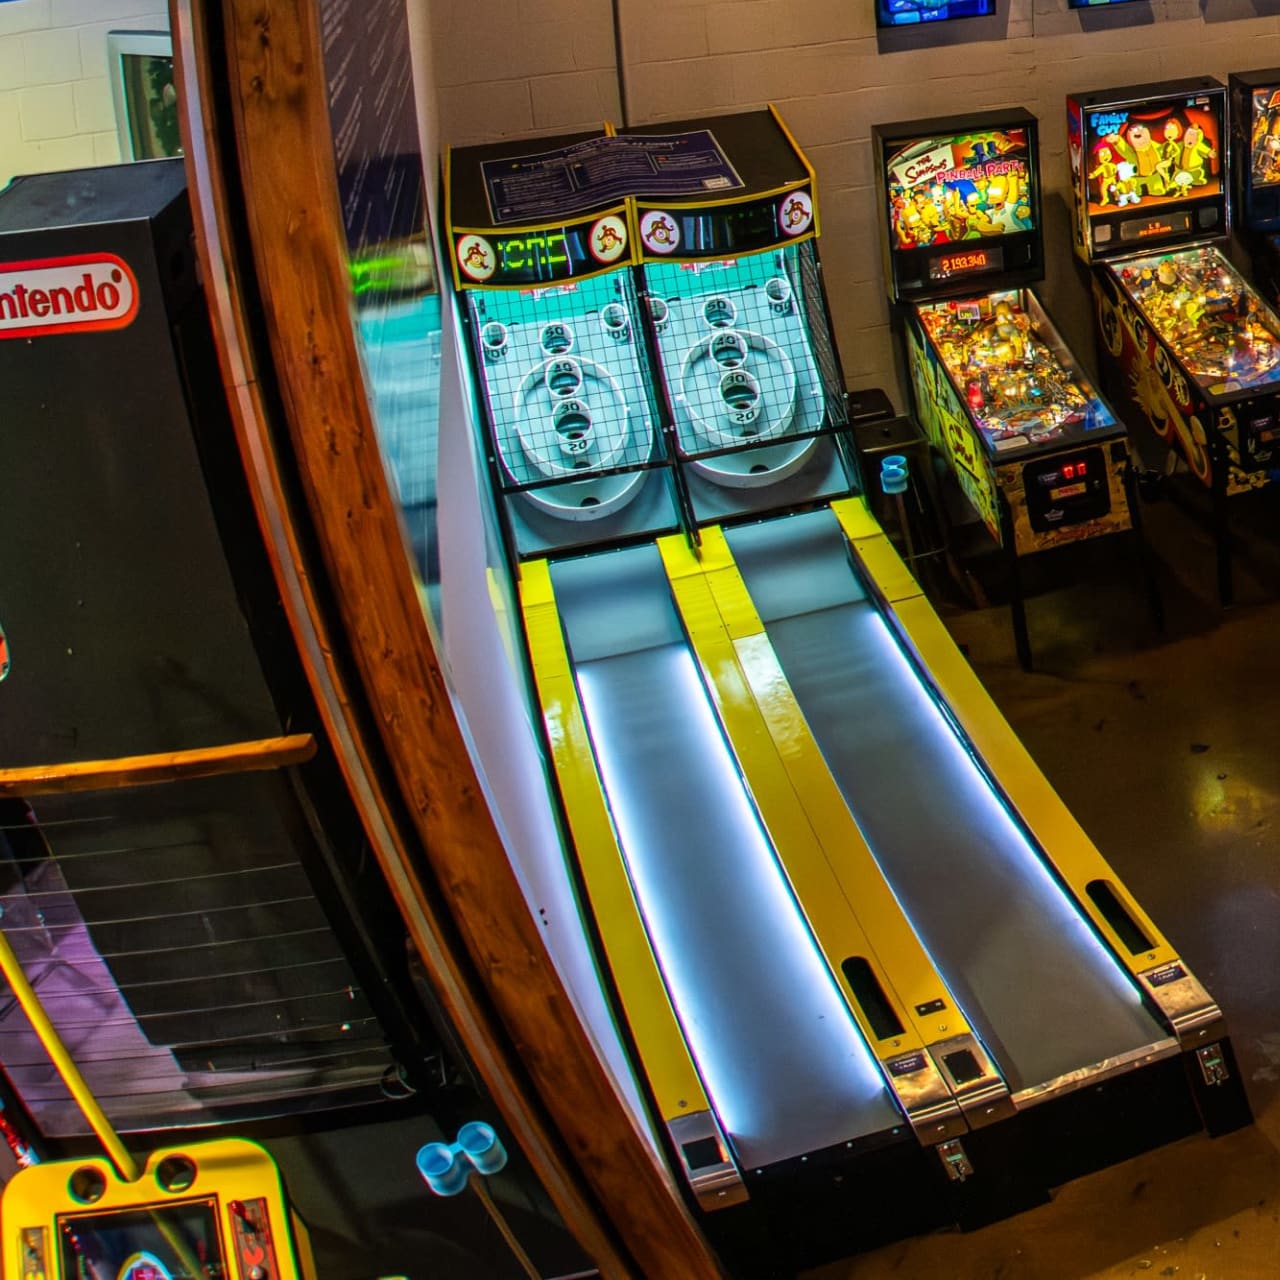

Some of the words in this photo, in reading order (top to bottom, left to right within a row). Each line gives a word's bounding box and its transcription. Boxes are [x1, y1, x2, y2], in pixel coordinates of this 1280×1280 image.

[1090, 112, 1129, 128] FAMILY
[1096, 125, 1121, 137] GUY
[936, 166, 985, 184] PINBALL
[985, 160, 1025, 178] PARTY
[568, 440, 588, 451] 20
